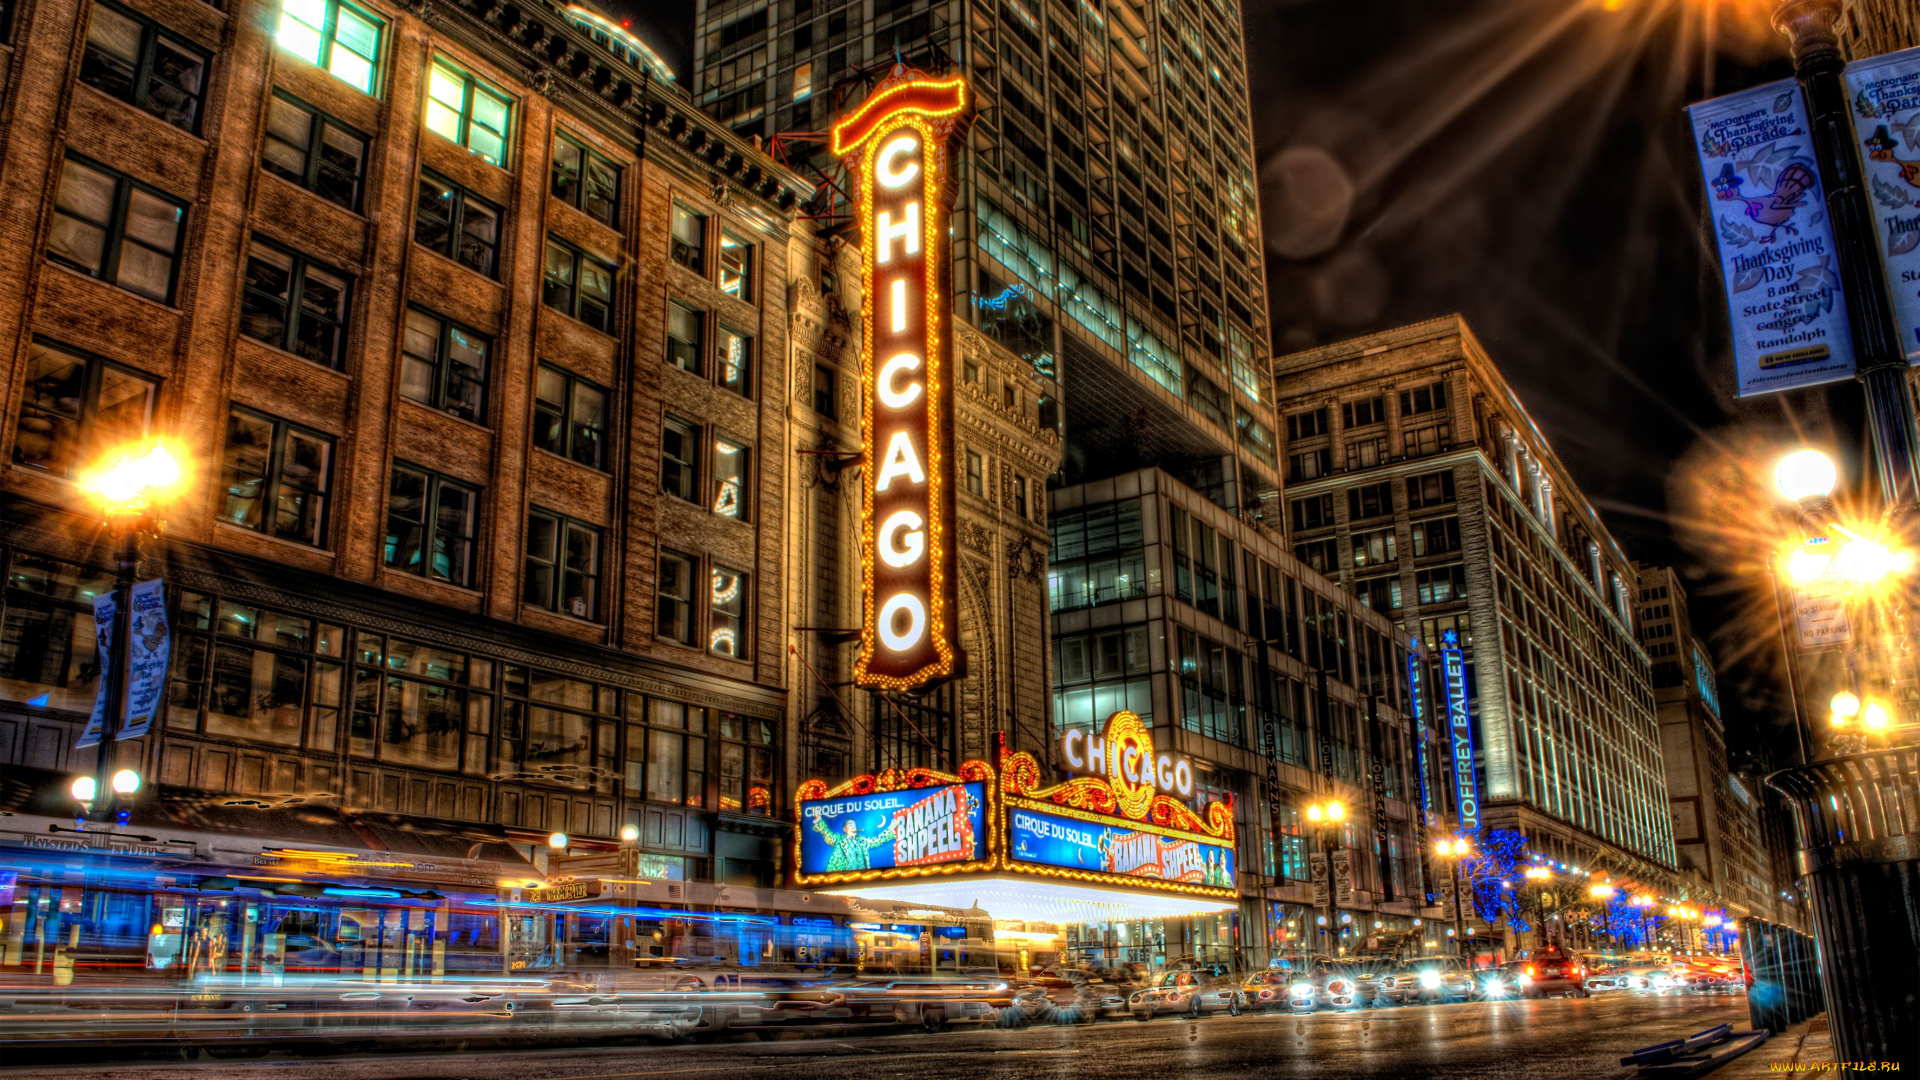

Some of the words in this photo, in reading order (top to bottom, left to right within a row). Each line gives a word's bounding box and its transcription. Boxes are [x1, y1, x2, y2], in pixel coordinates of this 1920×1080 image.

[1710, 108, 1767, 129] McDonald's
[1714, 112, 1795, 142] Thanksgiving
[1731, 126, 1787, 152] Parade
[1731, 236, 1825, 273] Thanksgiving
[1763, 263, 1795, 283] Day
[1743, 301, 1780, 317] State
[1783, 287, 1829, 308] Street
[1767, 287, 1776, 297] 8
[1778, 282, 1799, 295] am
[1756, 311, 1820, 331] Congress
[1774, 308, 1801, 319] from
[1757, 328, 1826, 350] Randolph
[876, 136, 925, 651] CHICAGO
[1803, 629, 1813, 637] NO
[1817, 625, 1847, 636] PARKING
[1445, 652, 1467, 727] BALLET
[1066, 729, 1191, 794] CHICAGO
[1264, 712, 1279, 814] LOEHMANNS
[1454, 733, 1477, 828] JOFFREY
[804, 803, 844, 818] CIRQUE
[846, 801, 861, 813] DU
[1372, 755, 1386, 840] LOEHMANNS
[897, 788, 957, 841] BANANA
[1015, 814, 1050, 838] CIRQUE
[1051, 824, 1065, 840] DU
[897, 812, 962, 863] SHPEEL
[1114, 833, 1158, 872] BANANA
[1161, 842, 1201, 879] SHPEEL
